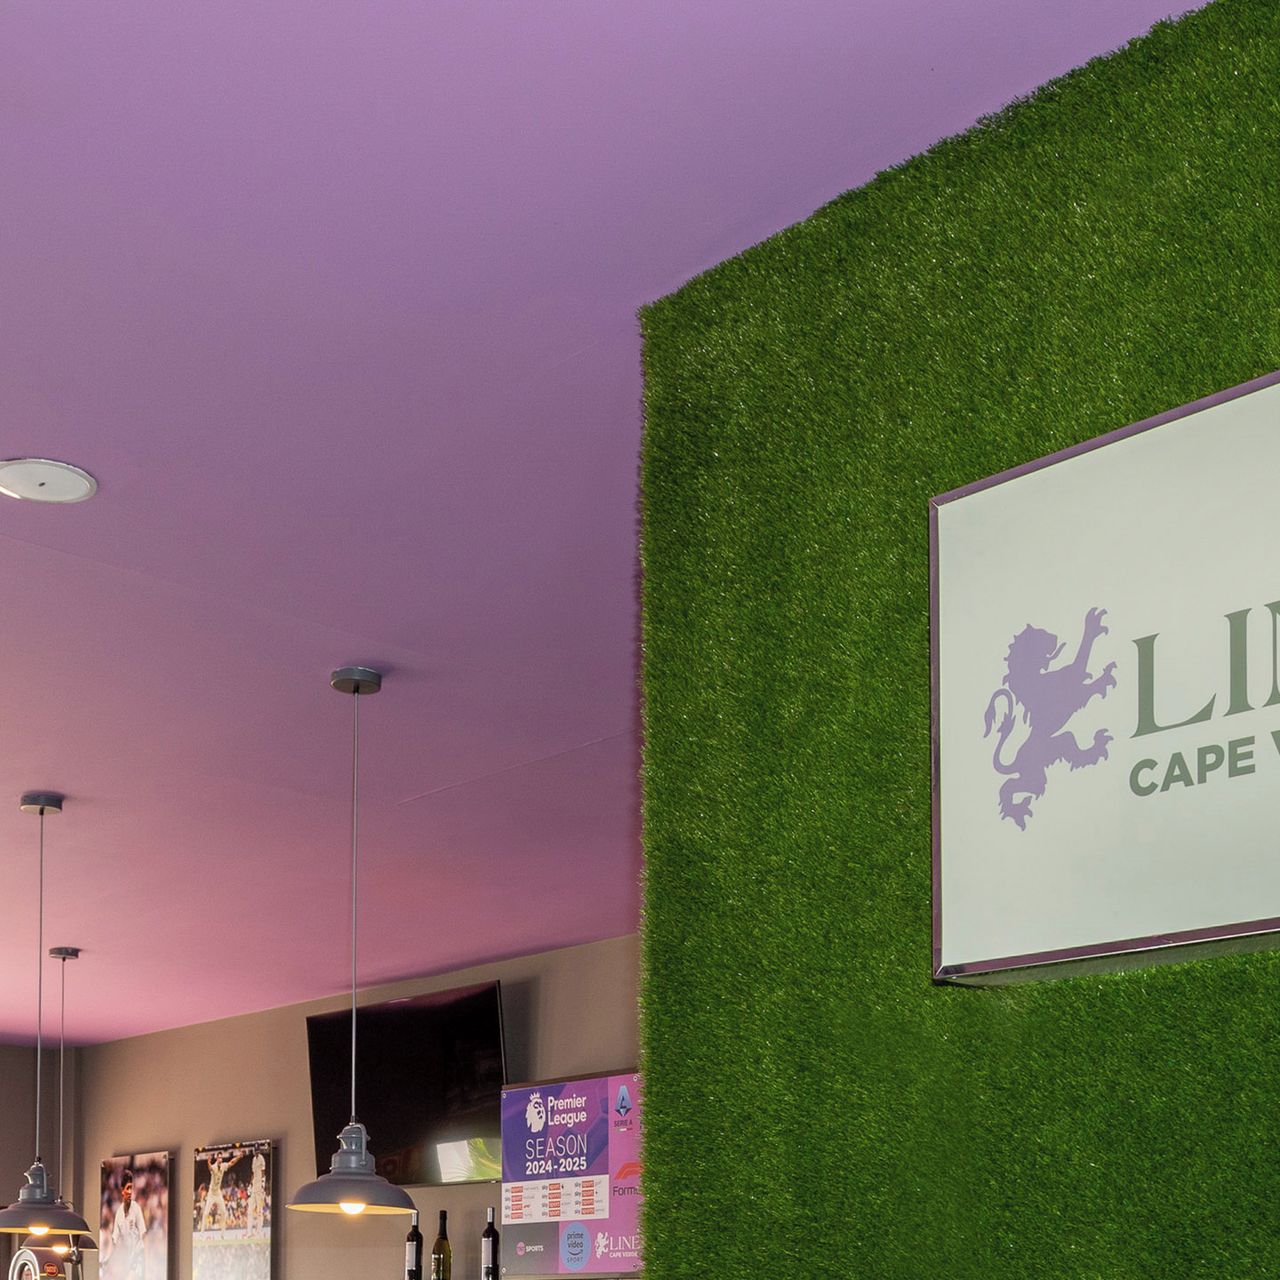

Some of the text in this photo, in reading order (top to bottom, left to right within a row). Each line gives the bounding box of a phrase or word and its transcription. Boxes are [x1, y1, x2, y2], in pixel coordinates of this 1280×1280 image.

[1128, 734, 1256, 798] CAPE
[547, 1094, 587, 1110] Premier
[547, 1111, 587, 1127] League
[525, 1134, 587, 1160] SEASON
[566, 1231, 584, 1241] prime
[567, 1239, 583, 1249] video
[525, 1245, 544, 1253] SPORTS
